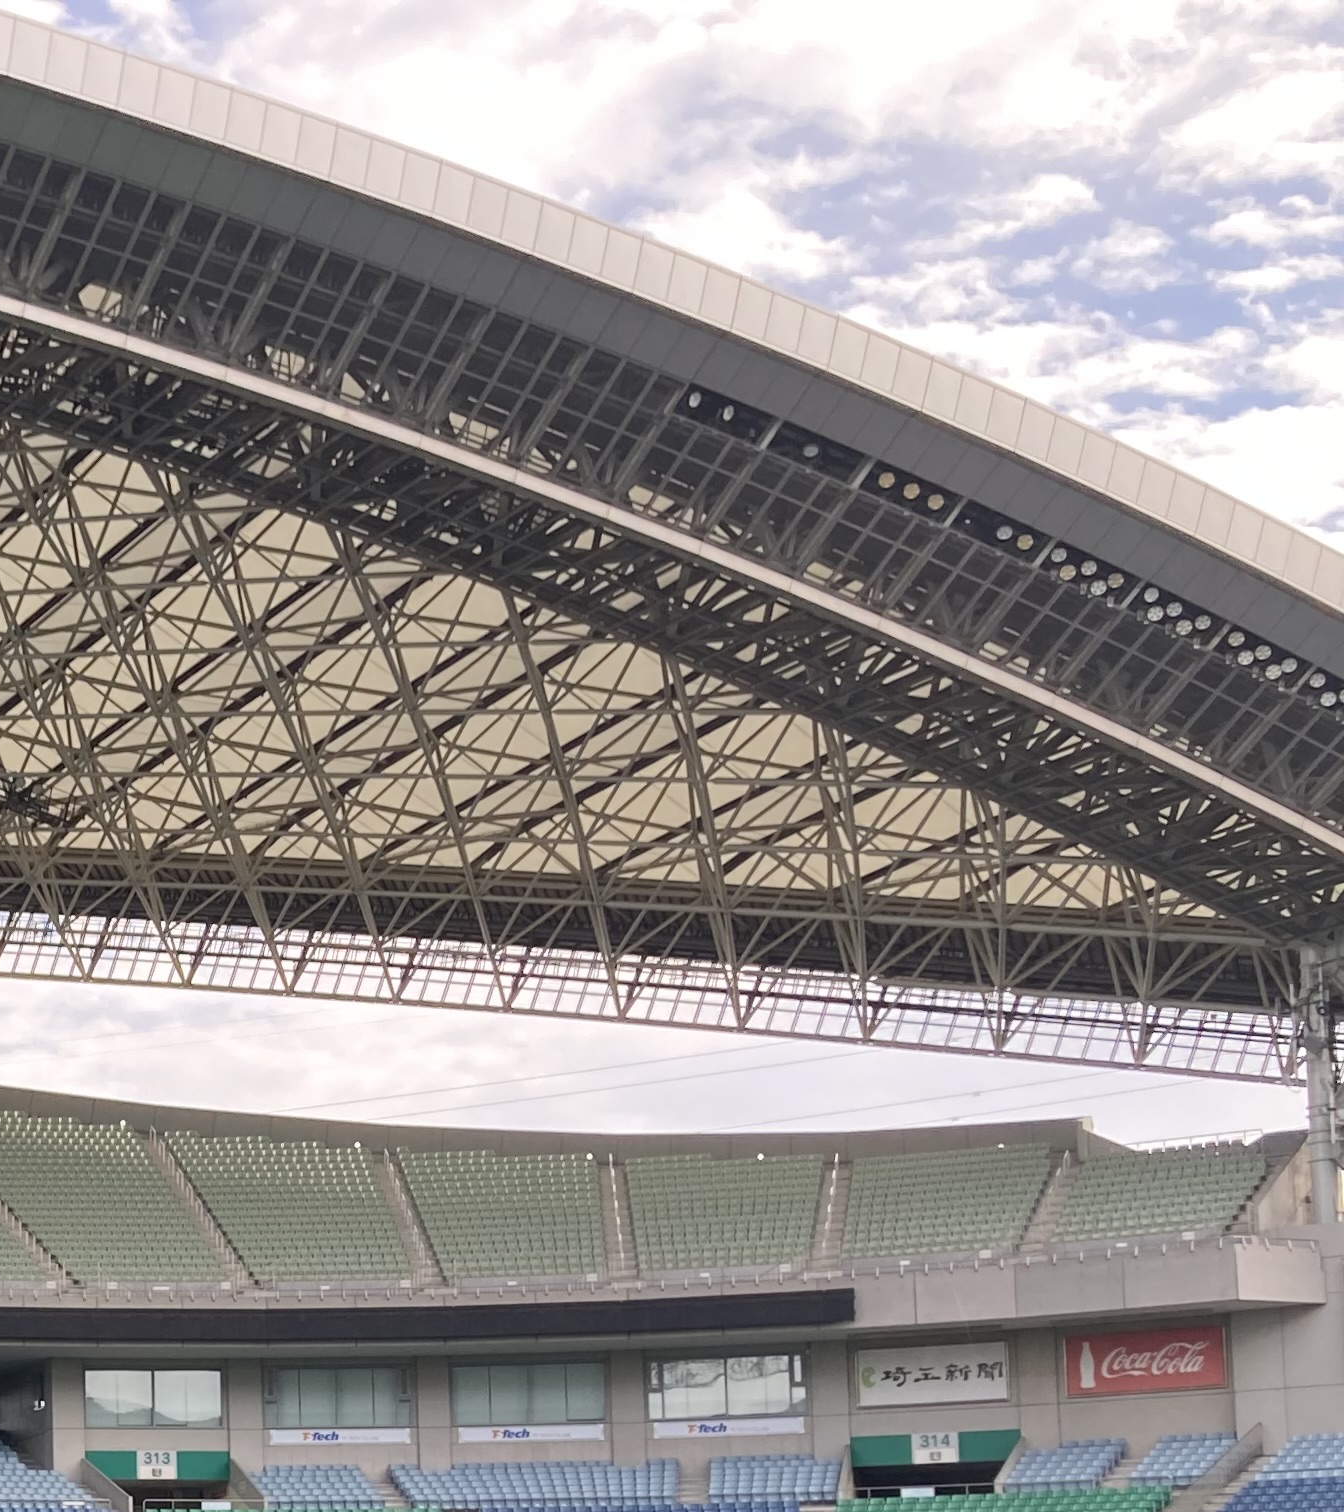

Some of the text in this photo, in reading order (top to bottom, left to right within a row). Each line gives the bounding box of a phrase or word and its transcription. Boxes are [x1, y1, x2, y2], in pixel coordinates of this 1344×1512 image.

[1101, 1341, 1210, 1379] Coca-Cola
[880, 1361, 1004, 1387] 埼玉新聞
[920, 1434, 951, 1448] 314
[143, 1452, 171, 1465] 313
